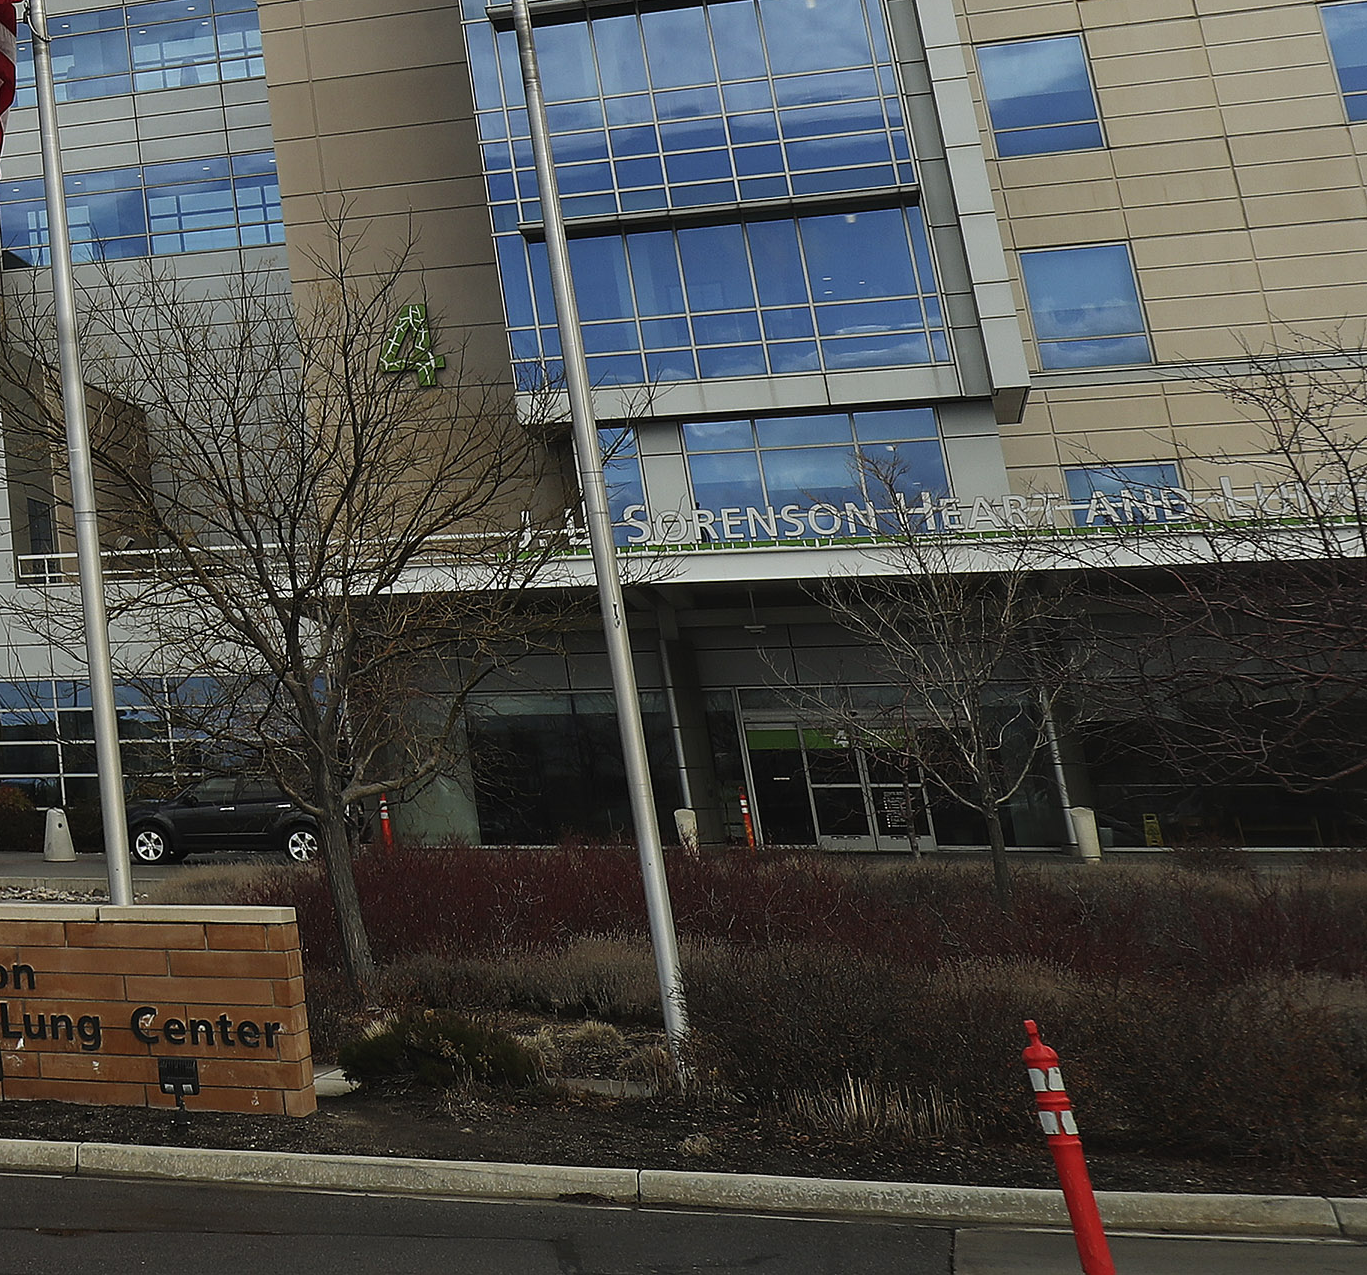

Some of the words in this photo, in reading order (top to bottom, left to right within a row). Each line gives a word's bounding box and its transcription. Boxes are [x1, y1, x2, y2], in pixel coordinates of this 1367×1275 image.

[379, 303, 446, 387] 4
[623, 501, 875, 545] SORENSON
[895, 490, 1060, 532] HEART
[1085, 486, 1193, 525] AND
[0, 1000, 102, 1051] Lung
[130, 1006, 280, 1049] Center
